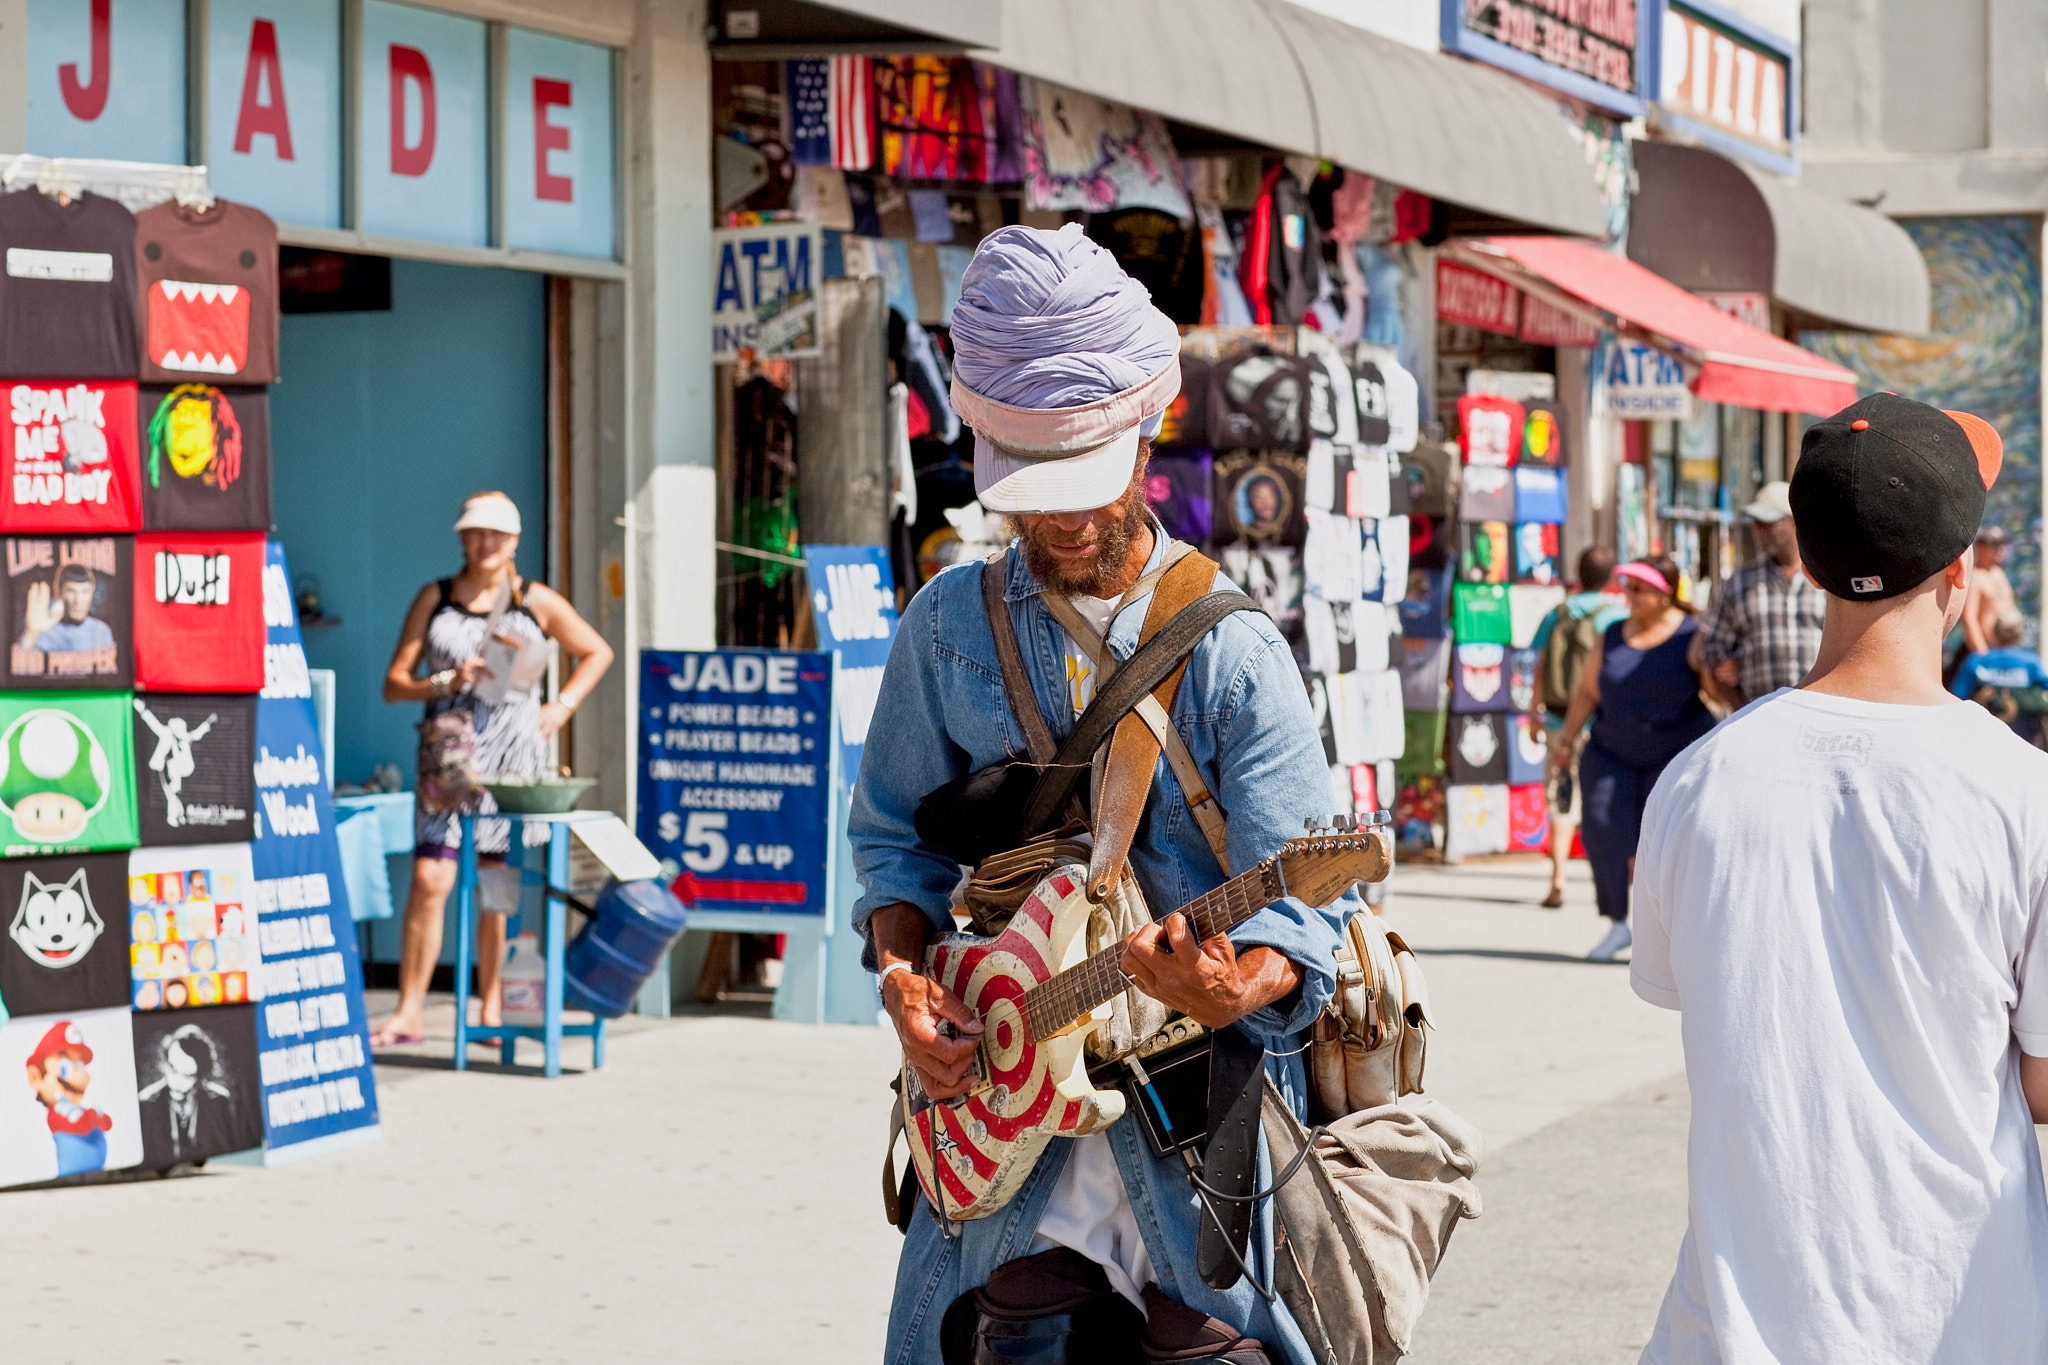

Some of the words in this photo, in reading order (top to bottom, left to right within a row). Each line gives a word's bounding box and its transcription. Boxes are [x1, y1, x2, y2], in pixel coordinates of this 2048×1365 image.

[59, 0, 574, 204] JADE
[714, 235, 811, 311] ATM
[11, 385, 105, 428] SPANK
[15, 425, 60, 460] ME
[13, 474, 64, 505] BAD
[64, 468, 112, 504] BOY
[6, 538, 54, 577] LIVE
[668, 655, 798, 694] JADE
[668, 703, 734, 724] POWER
[736, 705, 798, 728] BEADS
[664, 729, 736, 750] PRAYER
[739, 732, 801, 754] BEADS
[650, 758, 716, 782] UNIQUE
[718, 761, 816, 786] HANDMADE
[680, 786, 783, 811] ACCESSORY
[734, 845, 754, 865] &
[756, 844, 794, 870] up
